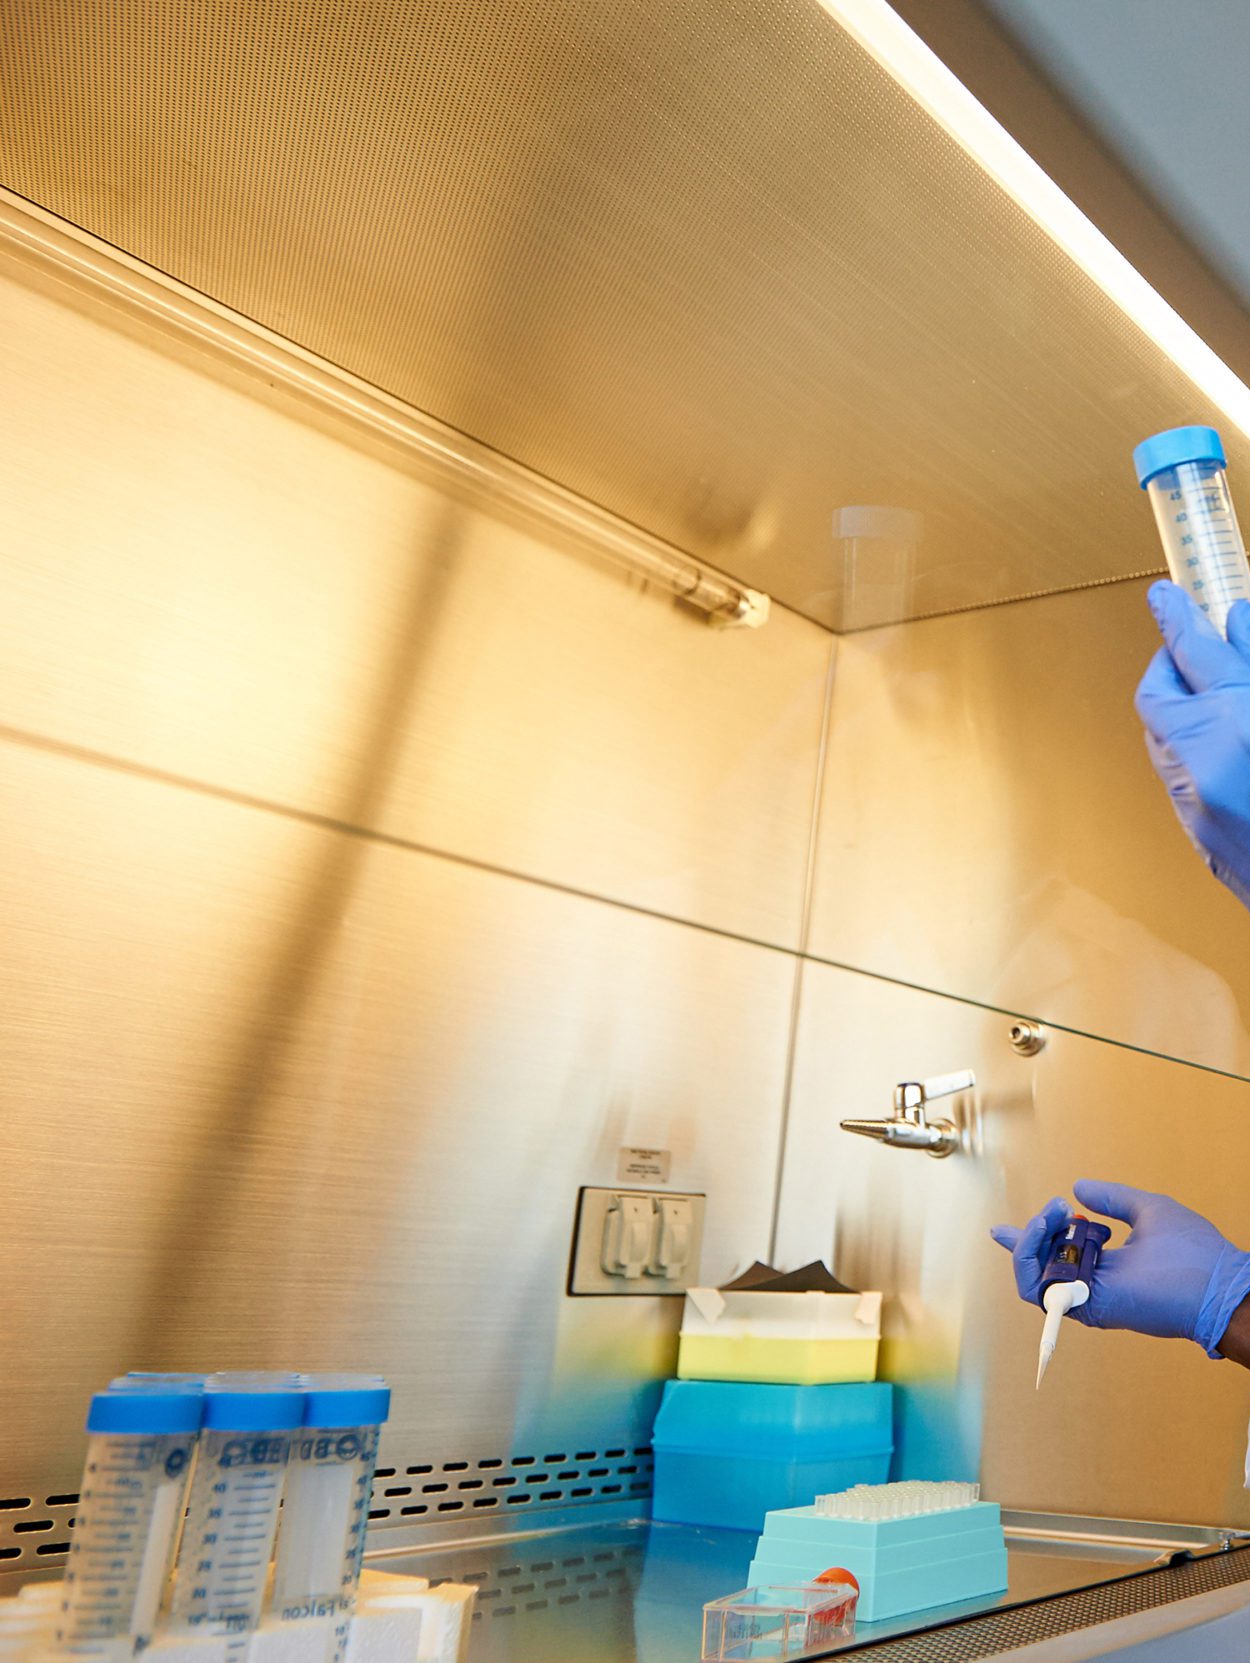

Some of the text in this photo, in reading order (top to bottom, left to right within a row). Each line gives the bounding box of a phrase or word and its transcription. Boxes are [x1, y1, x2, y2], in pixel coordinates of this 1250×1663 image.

[1170, 489, 1182, 501] 45
[1176, 512, 1188, 523] 40
[1181, 534, 1193, 546] 35
[213, 1482, 227, 1493] 40
